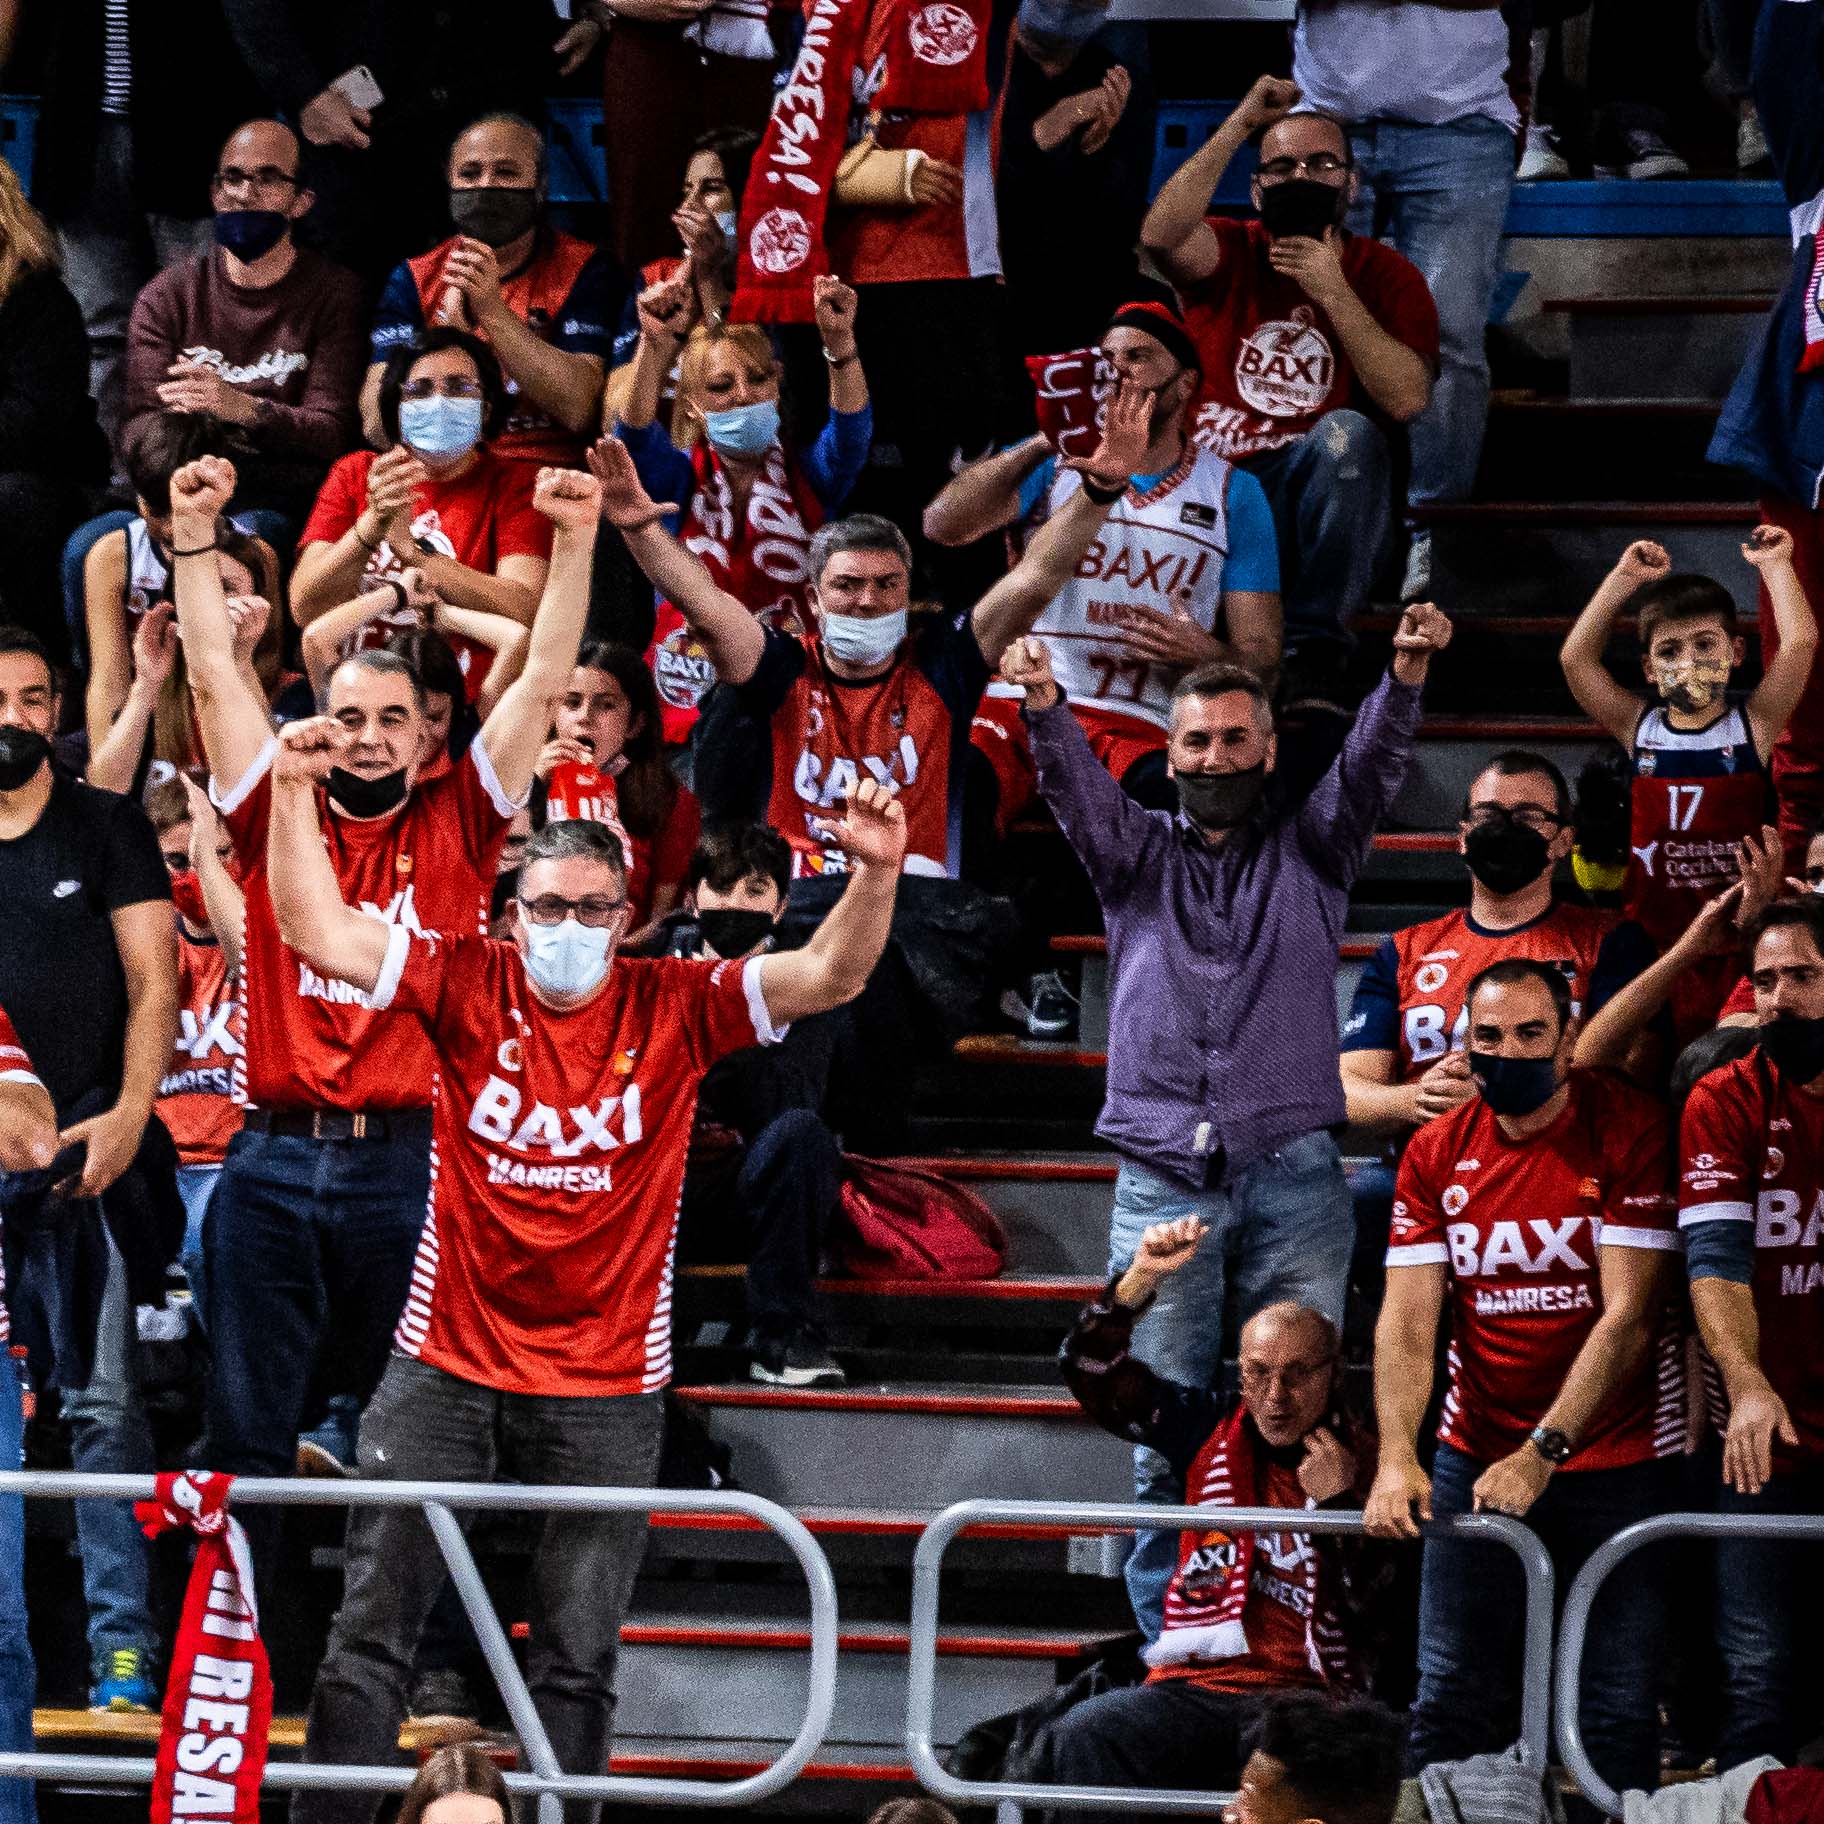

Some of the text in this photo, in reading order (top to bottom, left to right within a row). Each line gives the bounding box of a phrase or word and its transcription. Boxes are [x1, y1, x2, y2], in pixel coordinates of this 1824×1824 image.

[1239, 343, 1333, 386] BAXI
[1667, 786, 1705, 832] 17
[468, 1073, 643, 1158] BAXI
[1180, 1542, 1238, 1577] AXI
